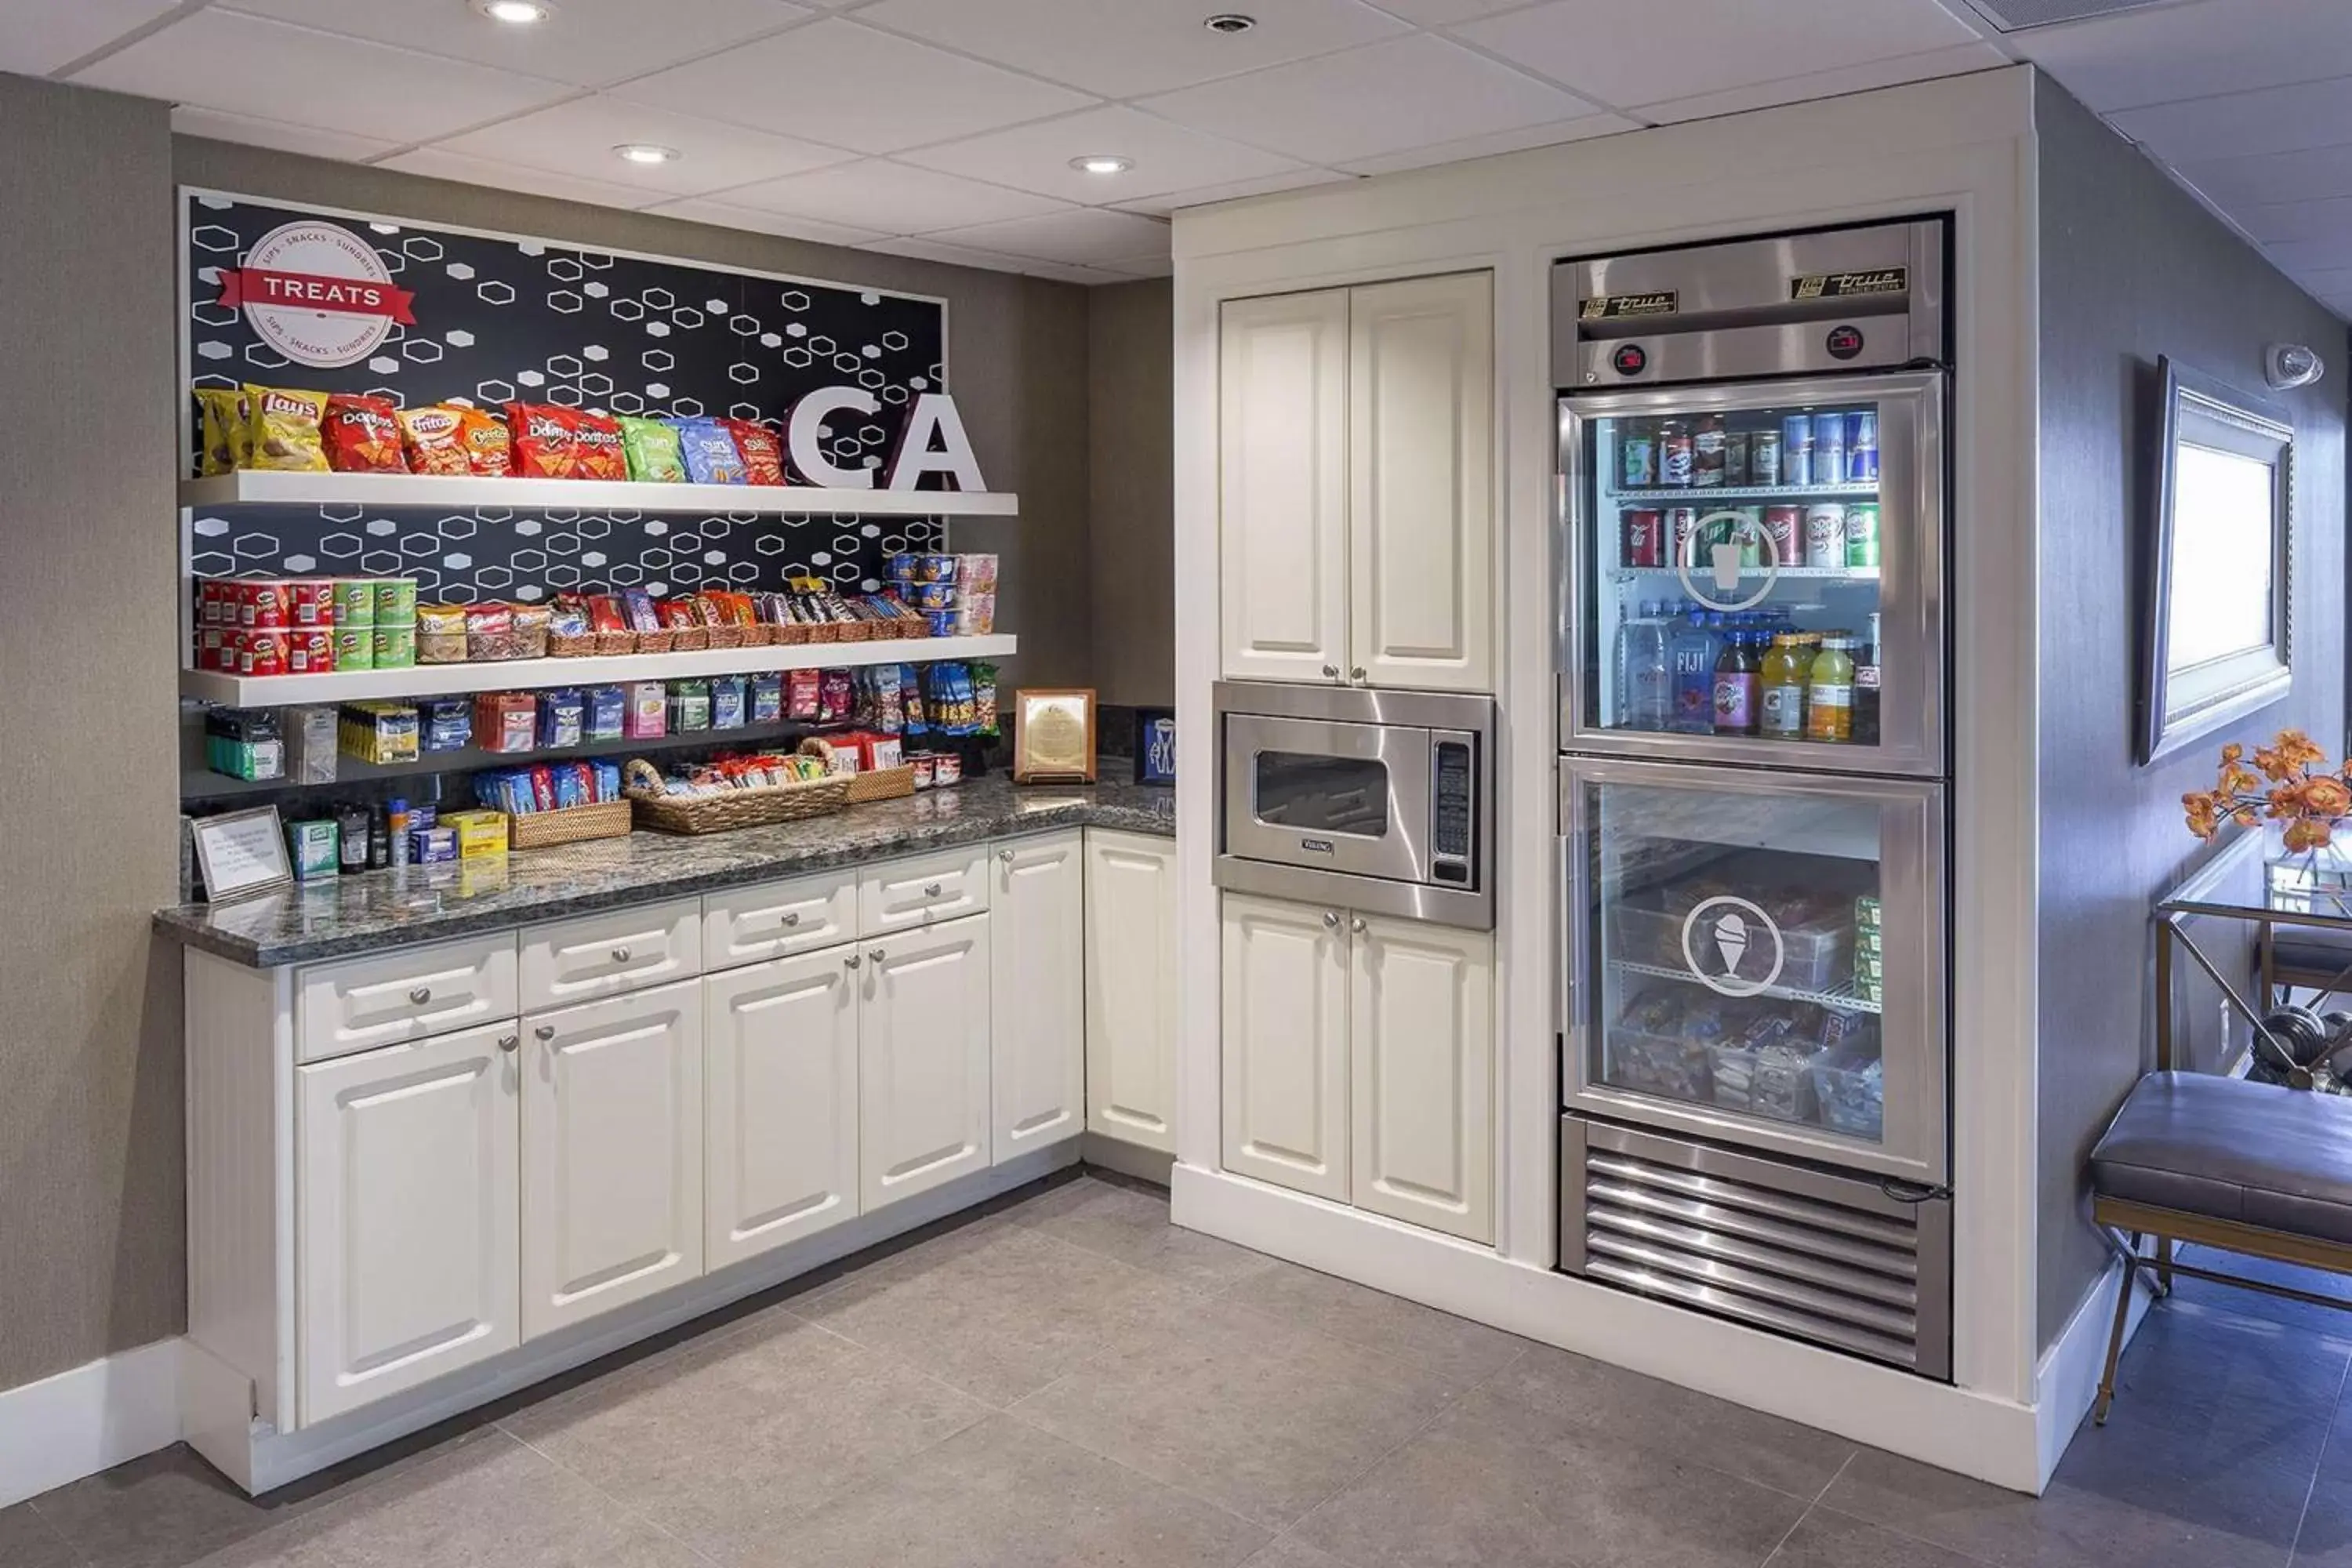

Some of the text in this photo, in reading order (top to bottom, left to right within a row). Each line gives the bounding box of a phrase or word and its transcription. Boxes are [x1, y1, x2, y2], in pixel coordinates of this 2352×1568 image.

[263, 232, 376, 277] SIPS SNACKS SUNDRIES
[263, 277, 382, 307] TREATS
[266, 315, 376, 355] SIPS SNACKS SUNDRIES
[1677, 651, 1705, 672] FIJI
